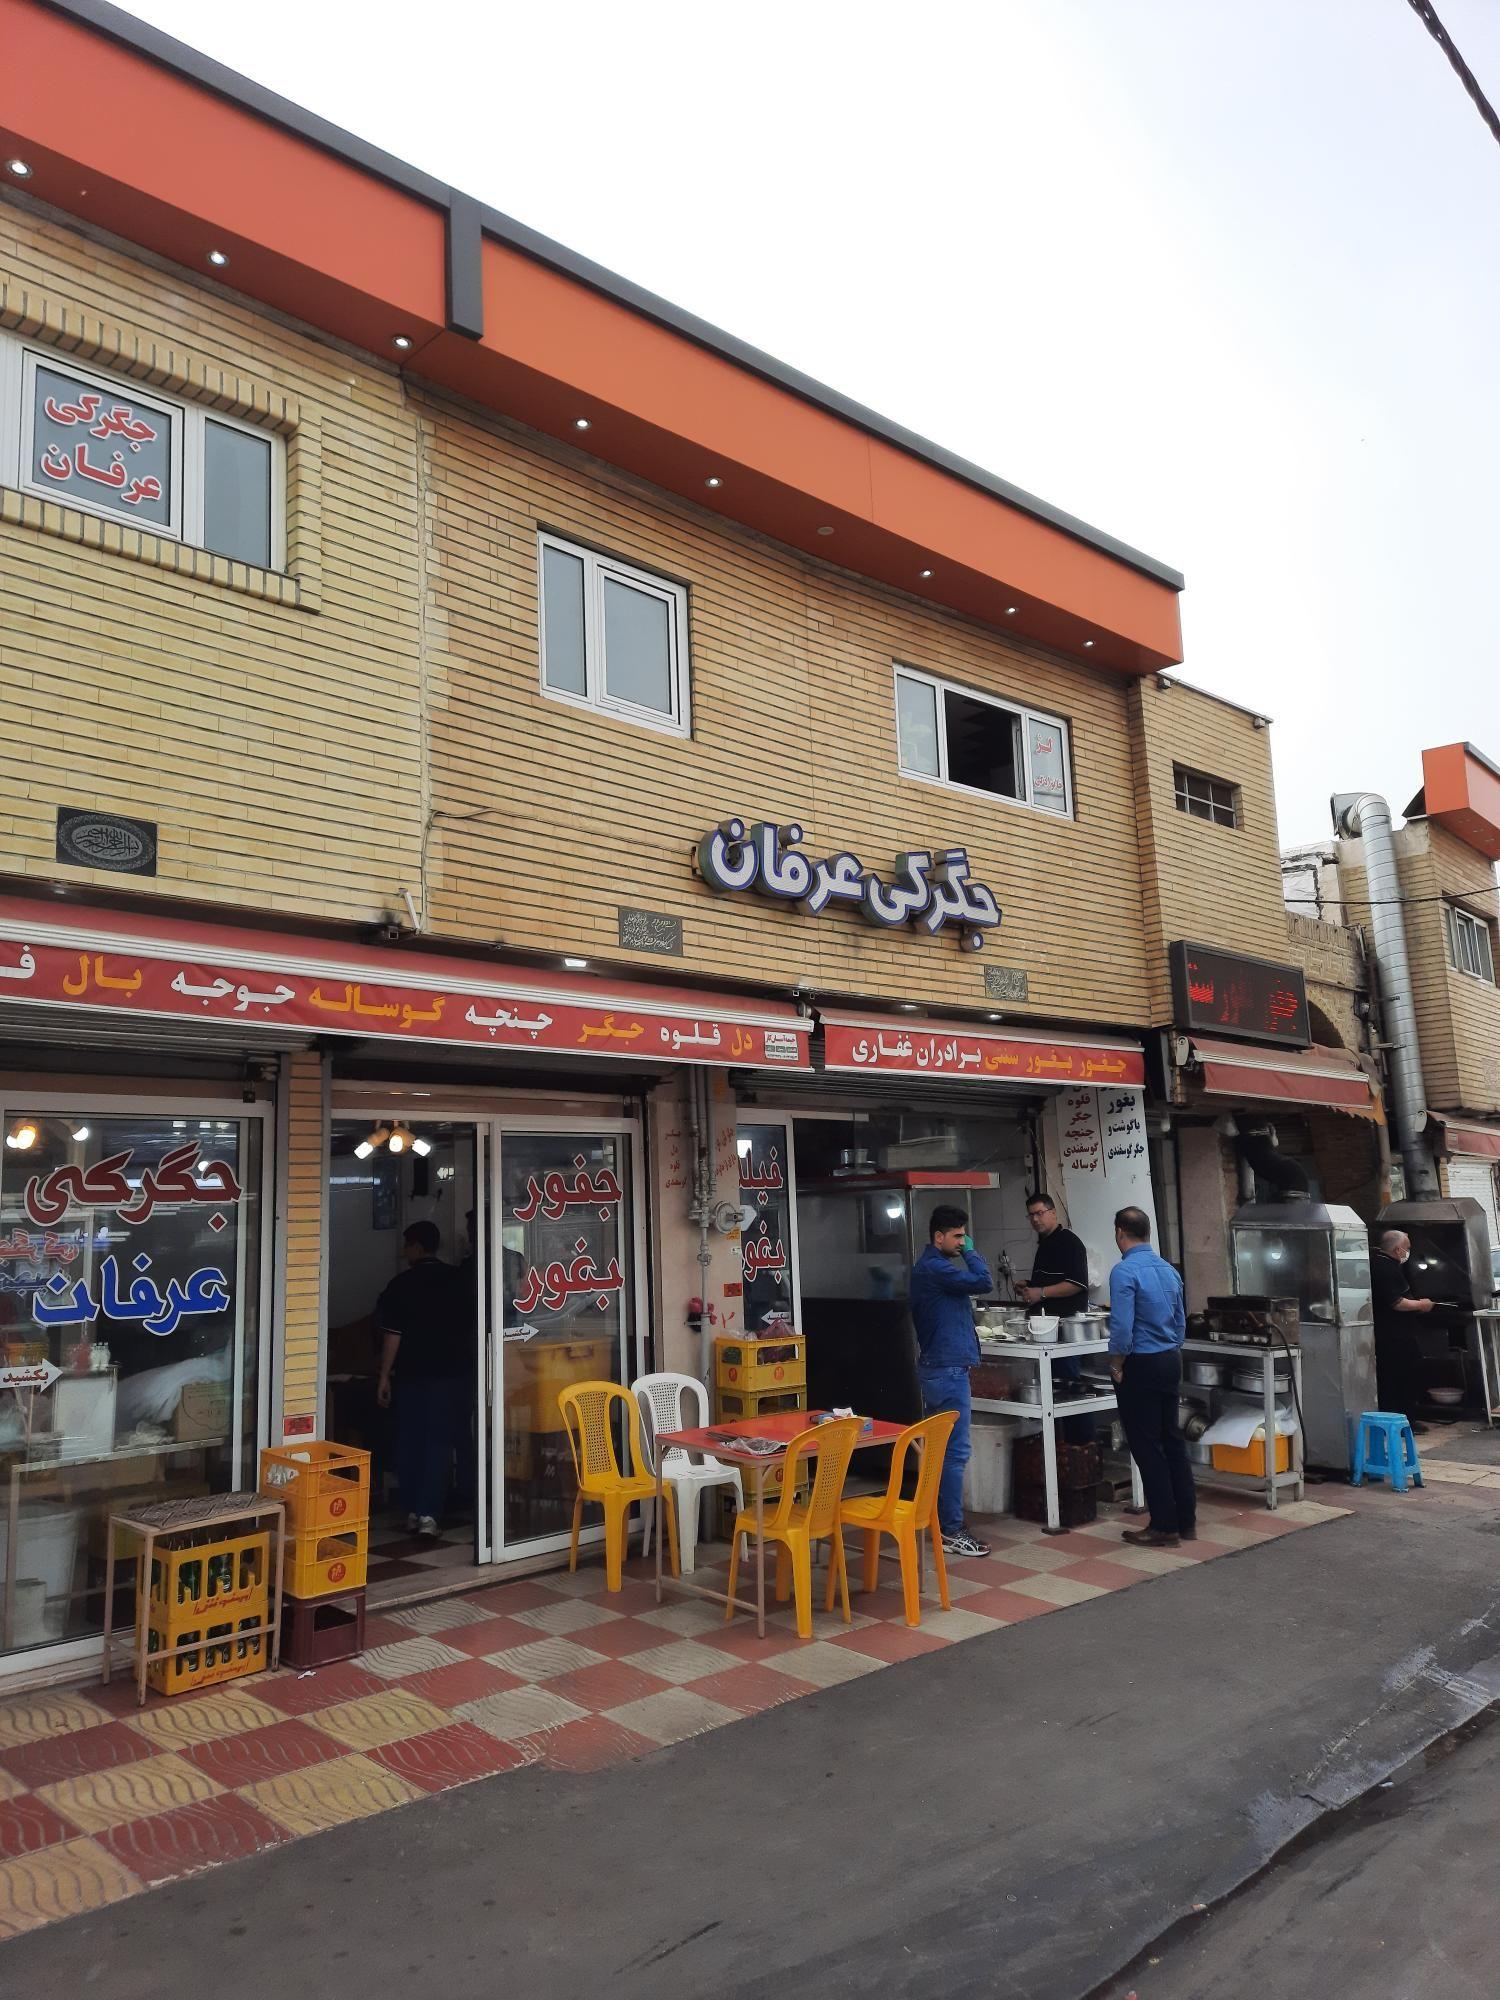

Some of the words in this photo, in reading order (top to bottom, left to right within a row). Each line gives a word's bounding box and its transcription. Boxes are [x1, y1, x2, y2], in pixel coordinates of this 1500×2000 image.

[45, 393, 157, 453] جگرکی
[41, 443, 162, 504] عرفان
[702, 818, 865, 916] عرفان
[860, 848, 1002, 953] جگرکی
[62, 954, 142, 998] بال
[170, 971, 296, 1013] جوجه
[308, 982, 446, 1029] گوساله
[465, 1004, 553, 1040] چنچه
[577, 1014, 645, 1046] جگر
[660, 1021, 721, 1050] قلوه
[731, 1026, 753, 1056] دل
[852, 1032, 913, 1064] غفاری
[916, 1038, 982, 1070] برادران
[1068, 1094, 1091, 1109] قلوه
[1070, 1111, 1092, 1126] جگر
[1107, 1092, 1136, 1115] بغور
[1063, 1141, 1099, 1157] گوسفندی
[1071, 1159, 1099, 1172] گوساله
[24, 1141, 244, 1233] جگرکی
[742, 1220, 787, 1285] بغو
[513, 1236, 625, 1314] بغور
[33, 1252, 230, 1336] عرفان
[3, 1368, 49, 1386] بکشید
